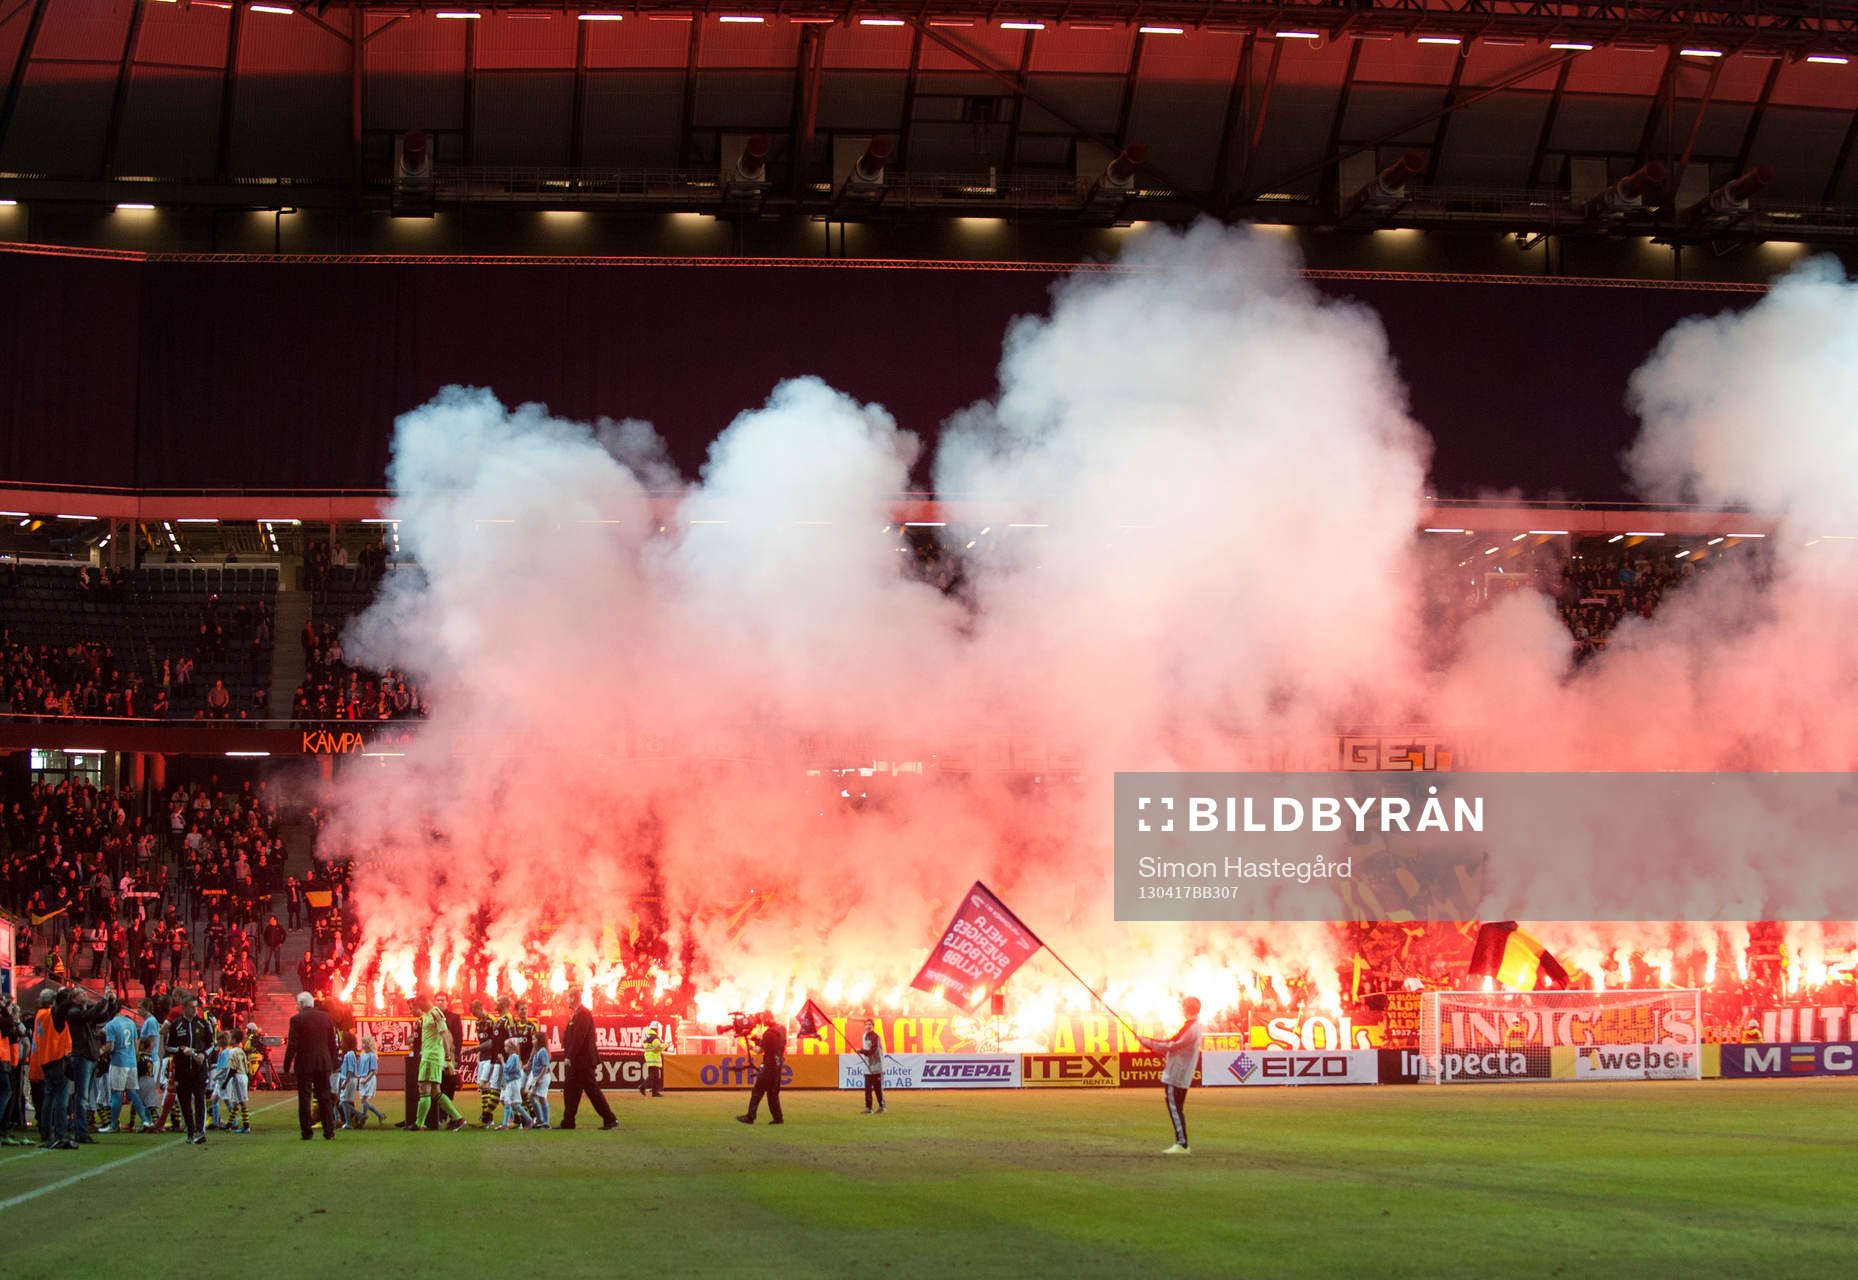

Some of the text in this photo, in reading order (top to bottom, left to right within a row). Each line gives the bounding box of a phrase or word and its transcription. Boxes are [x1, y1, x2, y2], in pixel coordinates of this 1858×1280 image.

[303, 730, 365, 753] KÄMPA
[1388, 1001, 1421, 1011] ALDR
[1389, 1020, 1421, 1029] ALDR
[1451, 1009, 1695, 1048] INVICS
[620, 1024, 675, 1052] NEA
[1024, 1056, 1112, 1079] ITEX
[1262, 1056, 1347, 1077] EIZO
[1401, 1050, 1527, 1080] Inspecta
[1600, 1046, 1693, 1070] weber
[701, 1057, 793, 1086] offie
[846, 1066, 912, 1076] Takukter
[922, 1064, 1012, 1077] KATEPAL
[896, 1078, 912, 1088] AB
